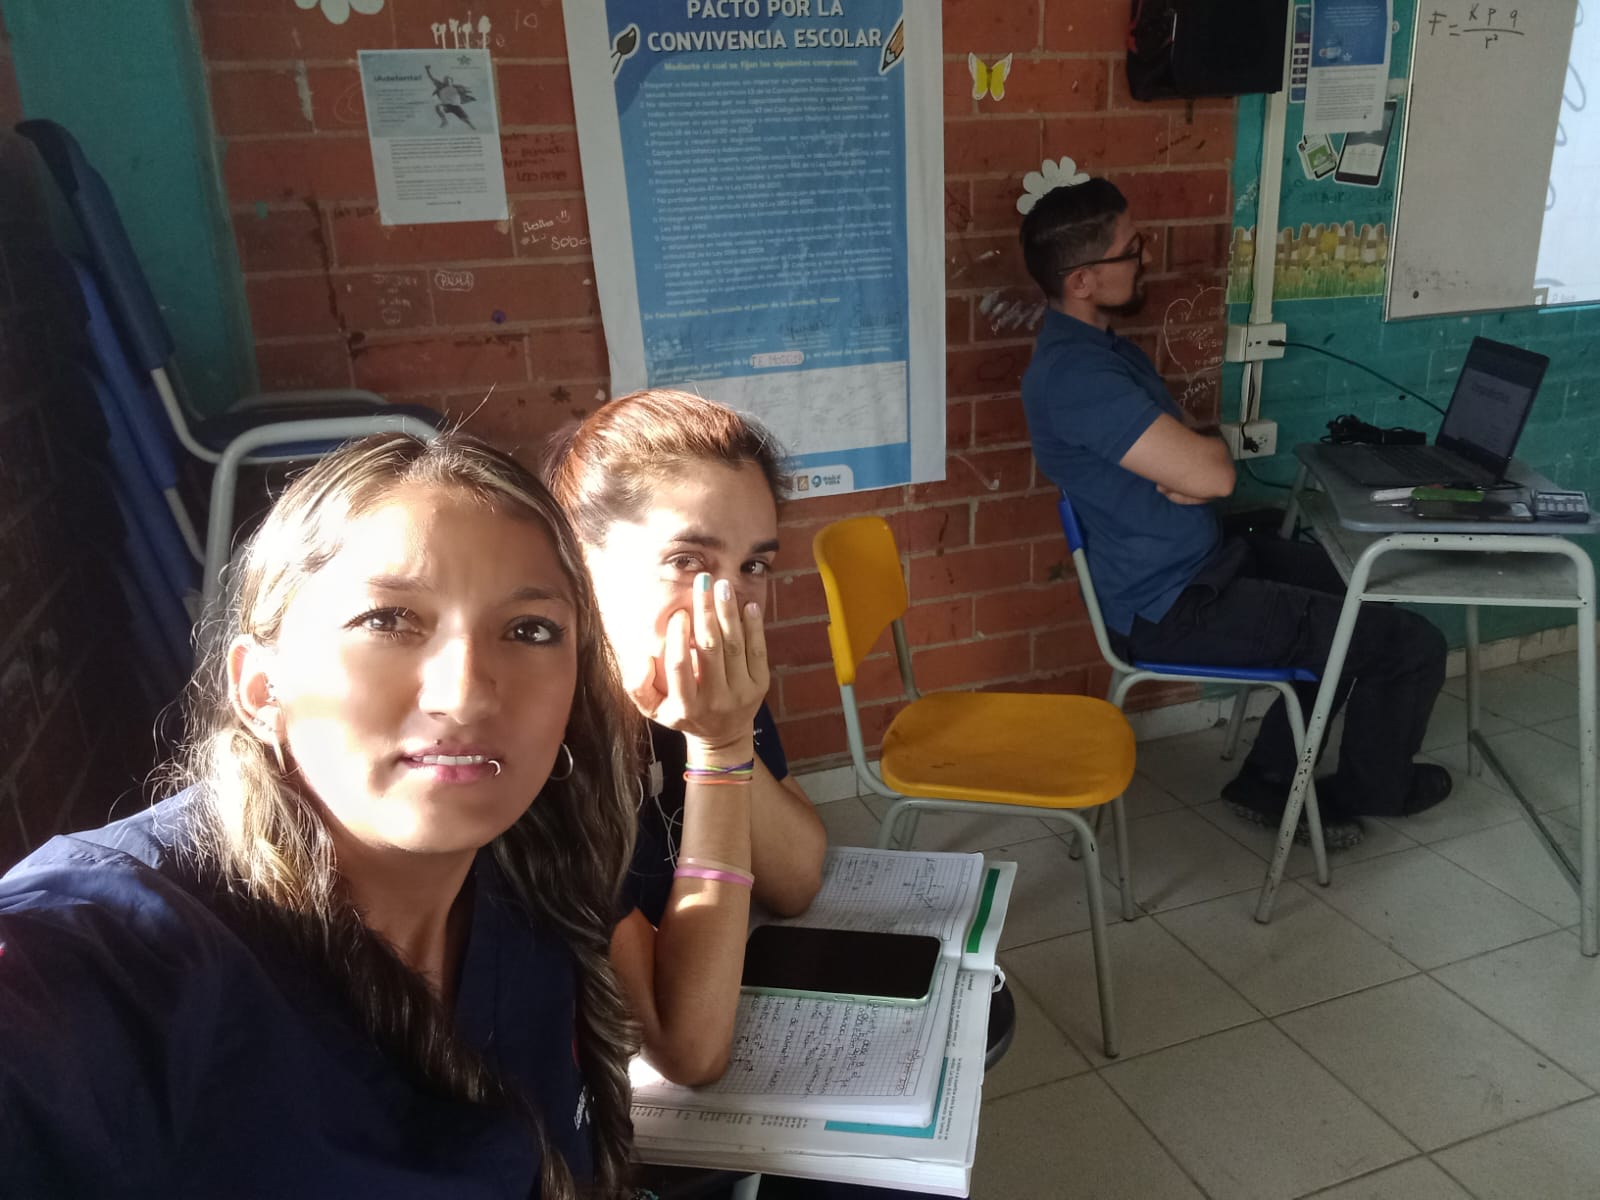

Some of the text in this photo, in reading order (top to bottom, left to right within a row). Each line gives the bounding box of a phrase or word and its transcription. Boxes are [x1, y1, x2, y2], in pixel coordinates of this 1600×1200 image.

[687, 0, 844, 19] PACTO POR LA
[648, 28, 882, 52] CONVIVENCIA ESCOLAR
